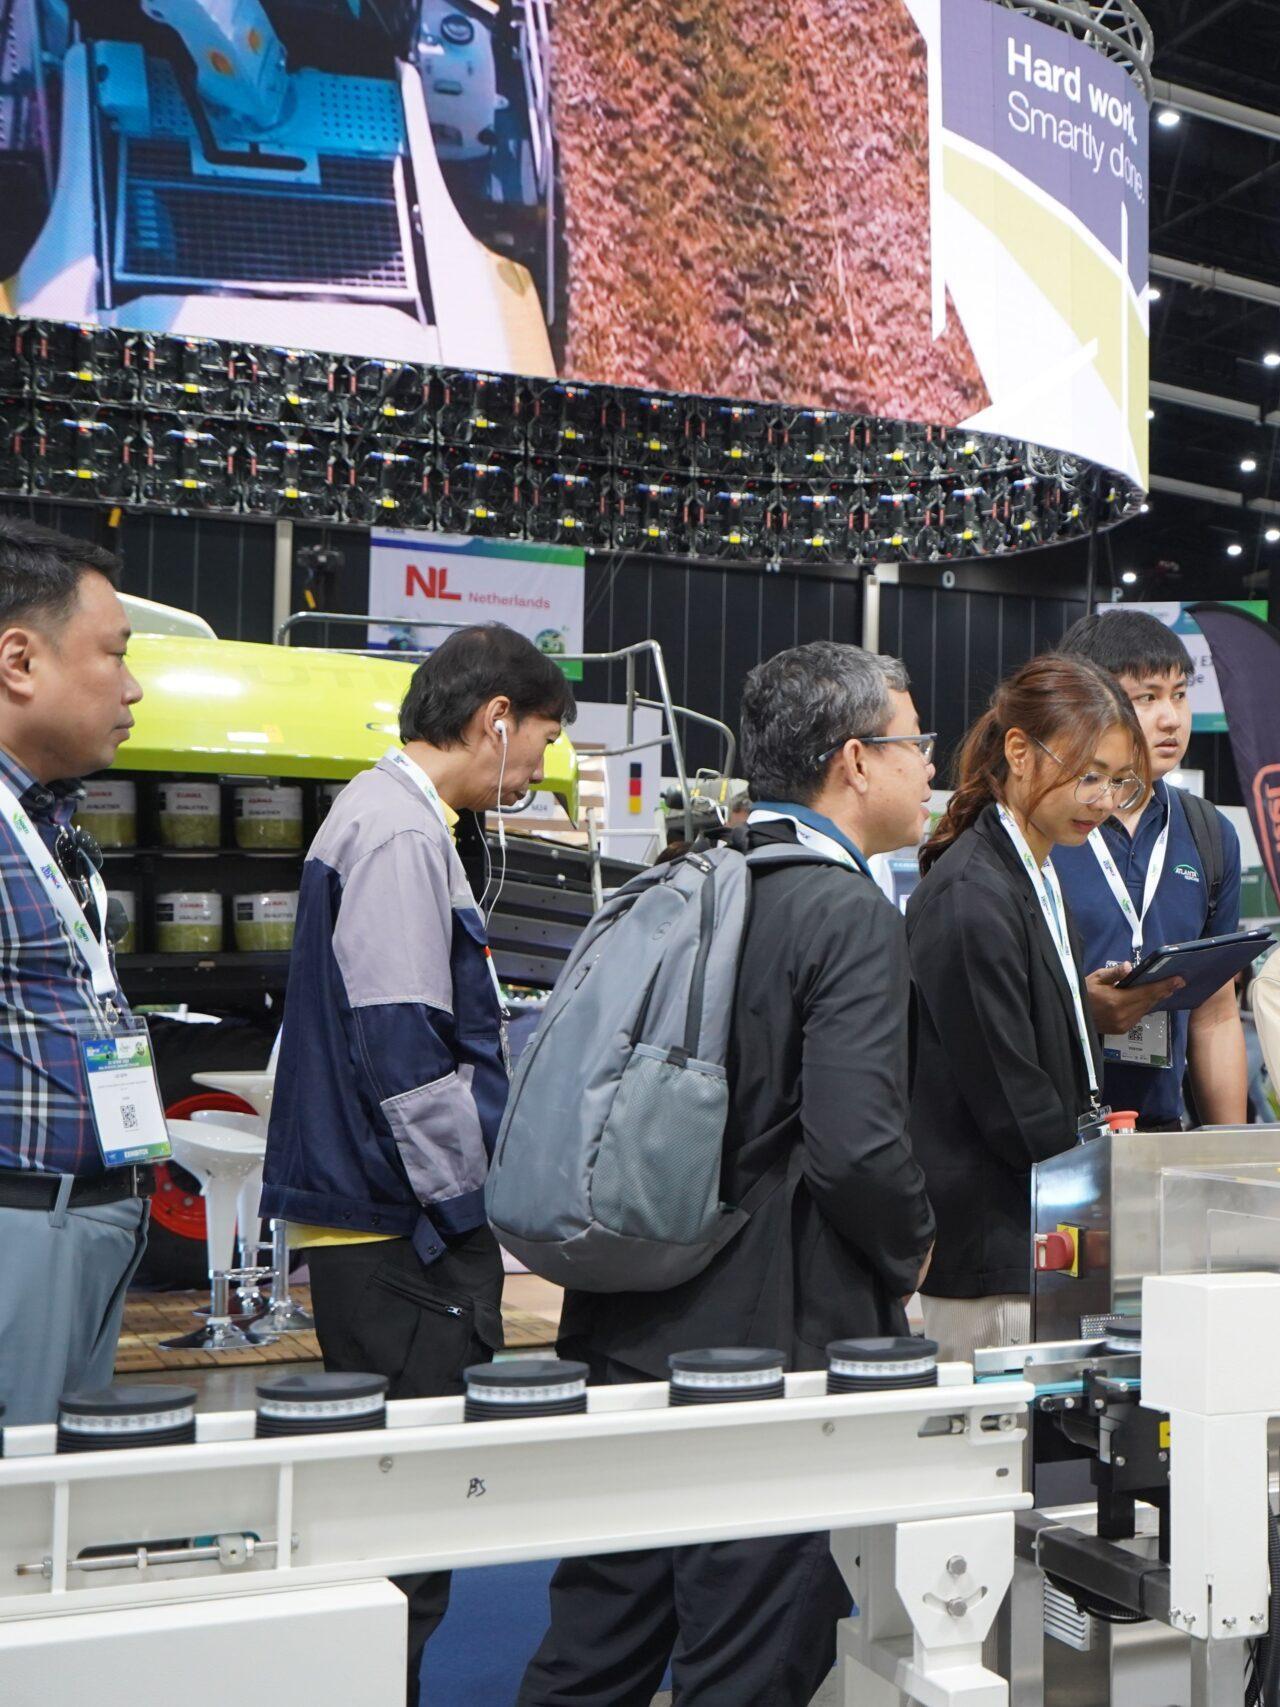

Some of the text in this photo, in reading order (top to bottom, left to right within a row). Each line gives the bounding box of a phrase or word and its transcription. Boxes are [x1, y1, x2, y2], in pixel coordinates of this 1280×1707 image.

[1007, 36, 1138, 146] Hard work.
[1007, 89, 1146, 204] Smartly done.
[405, 564, 551, 610] NL Netherlands
